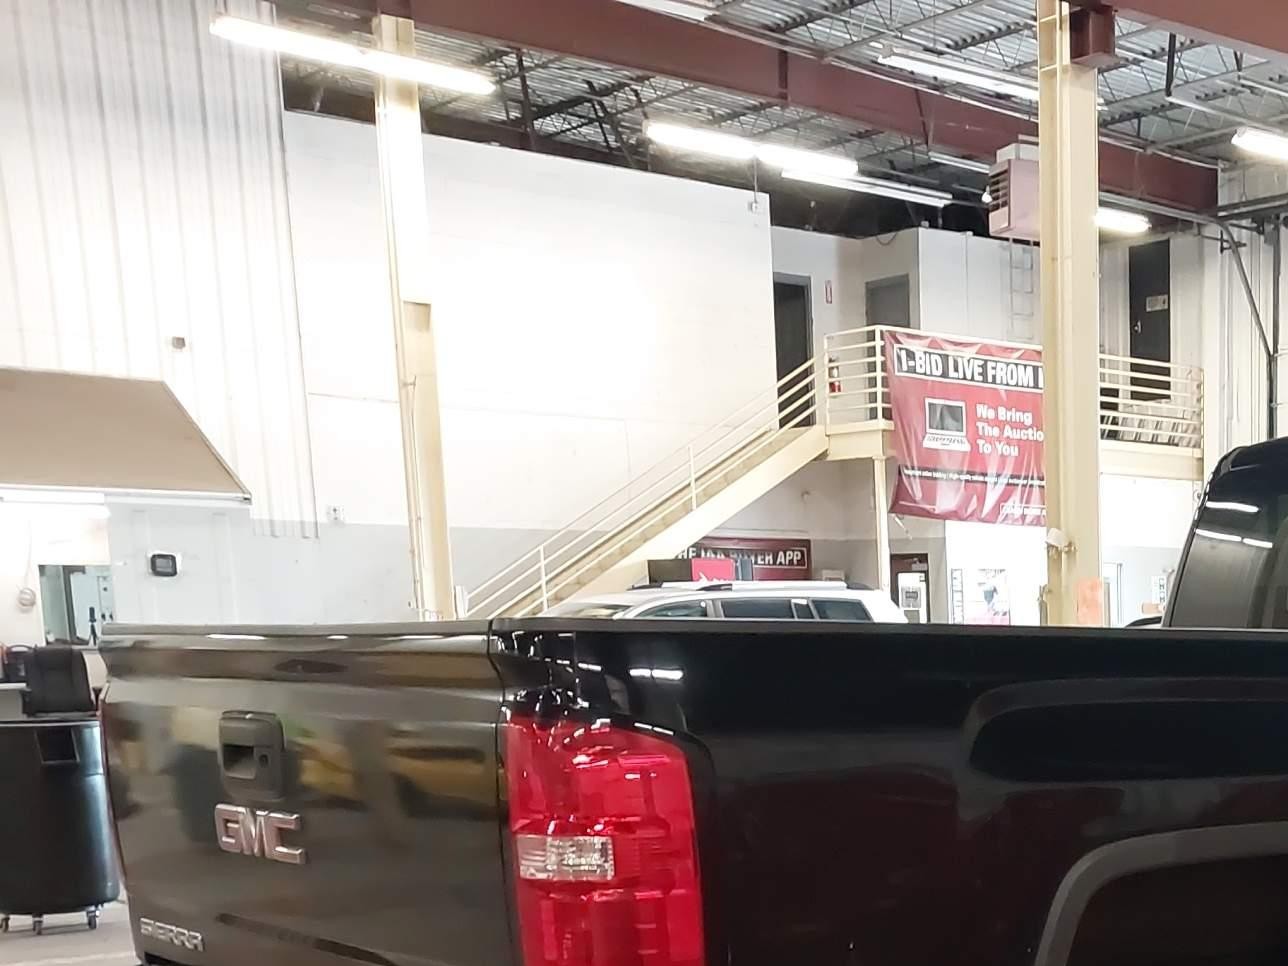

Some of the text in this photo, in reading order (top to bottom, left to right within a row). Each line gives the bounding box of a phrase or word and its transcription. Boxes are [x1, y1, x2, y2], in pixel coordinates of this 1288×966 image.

[948, 355, 985, 381] LIVE
[987, 360, 1034, 388] FROM
[976, 403, 1033, 426] We Bring
[976, 421, 1044, 441] The Auctio
[976, 438, 1019, 457] To You
[776, 551, 801, 565] APP
[215, 803, 307, 865] GMC
[140, 916, 204, 952] SIERRA
